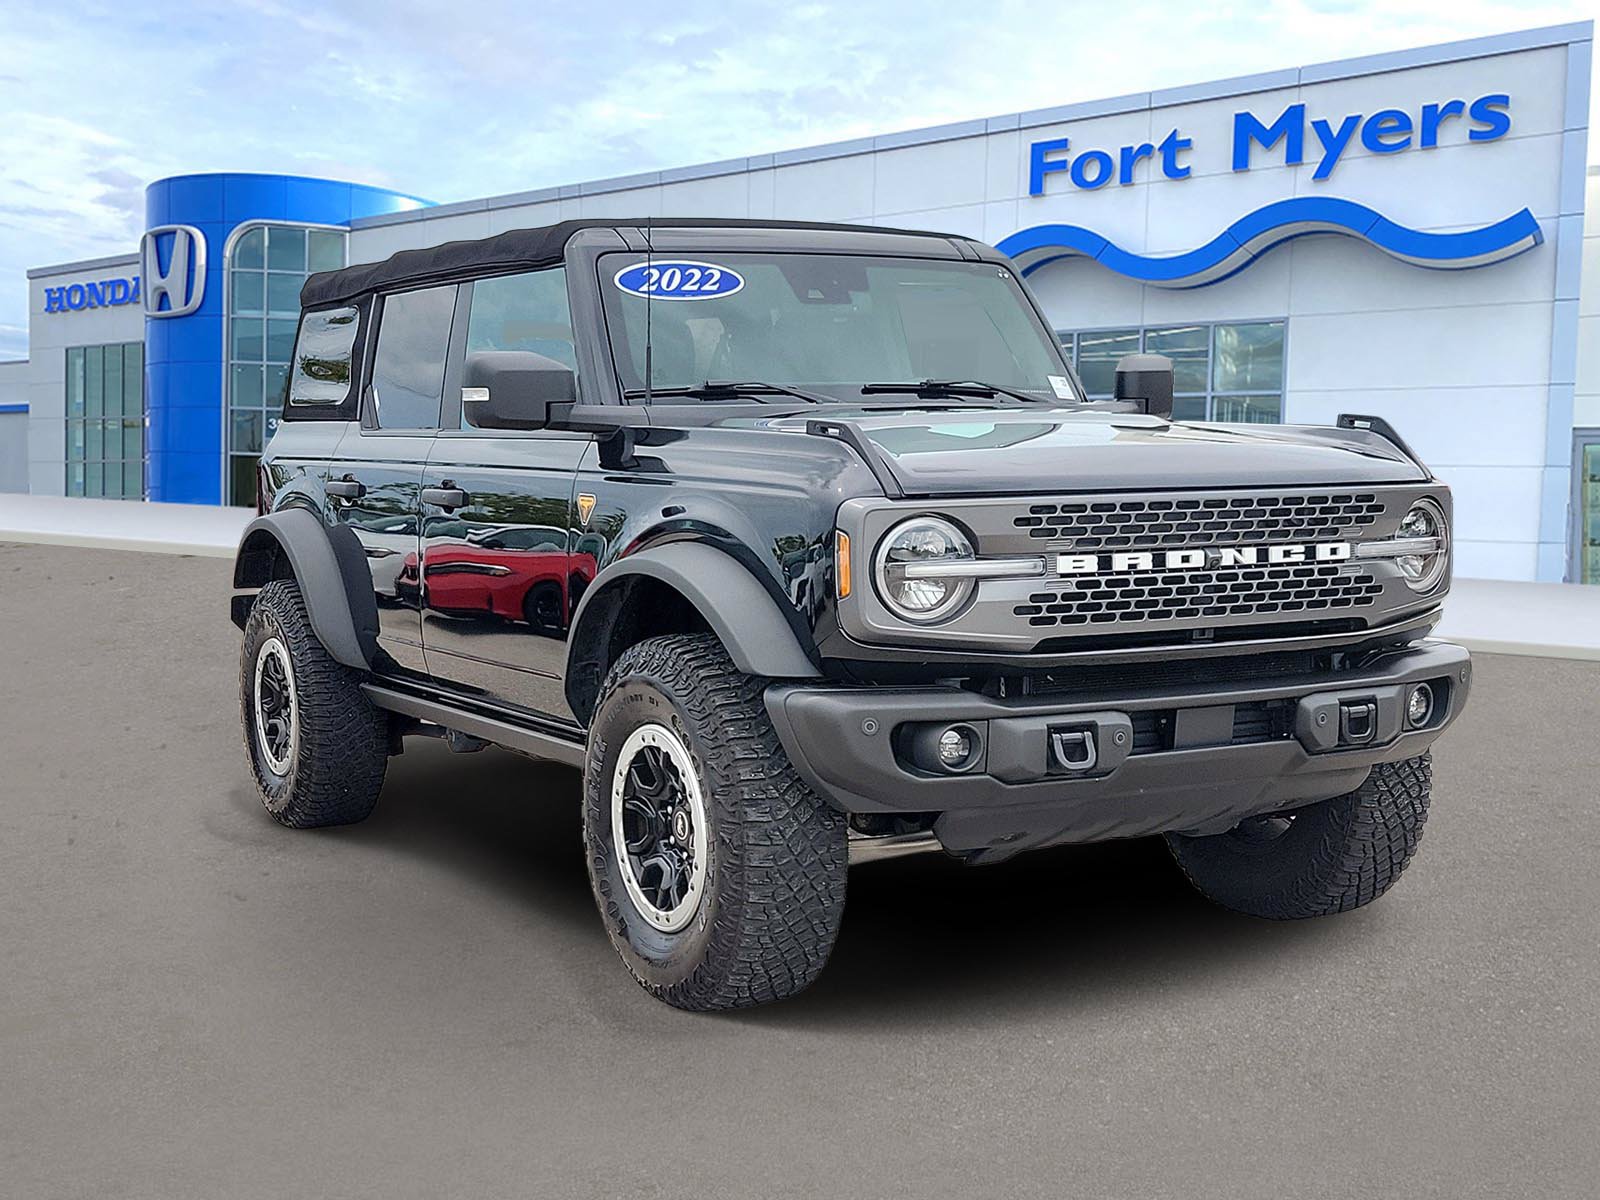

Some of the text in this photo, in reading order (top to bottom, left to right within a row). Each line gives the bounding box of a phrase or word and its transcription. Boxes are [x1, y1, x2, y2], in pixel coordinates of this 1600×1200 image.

[1029, 93, 1511, 197] Fort Myers
[638, 267, 721, 292] 2022
[1056, 543, 1351, 574] BRONCO
